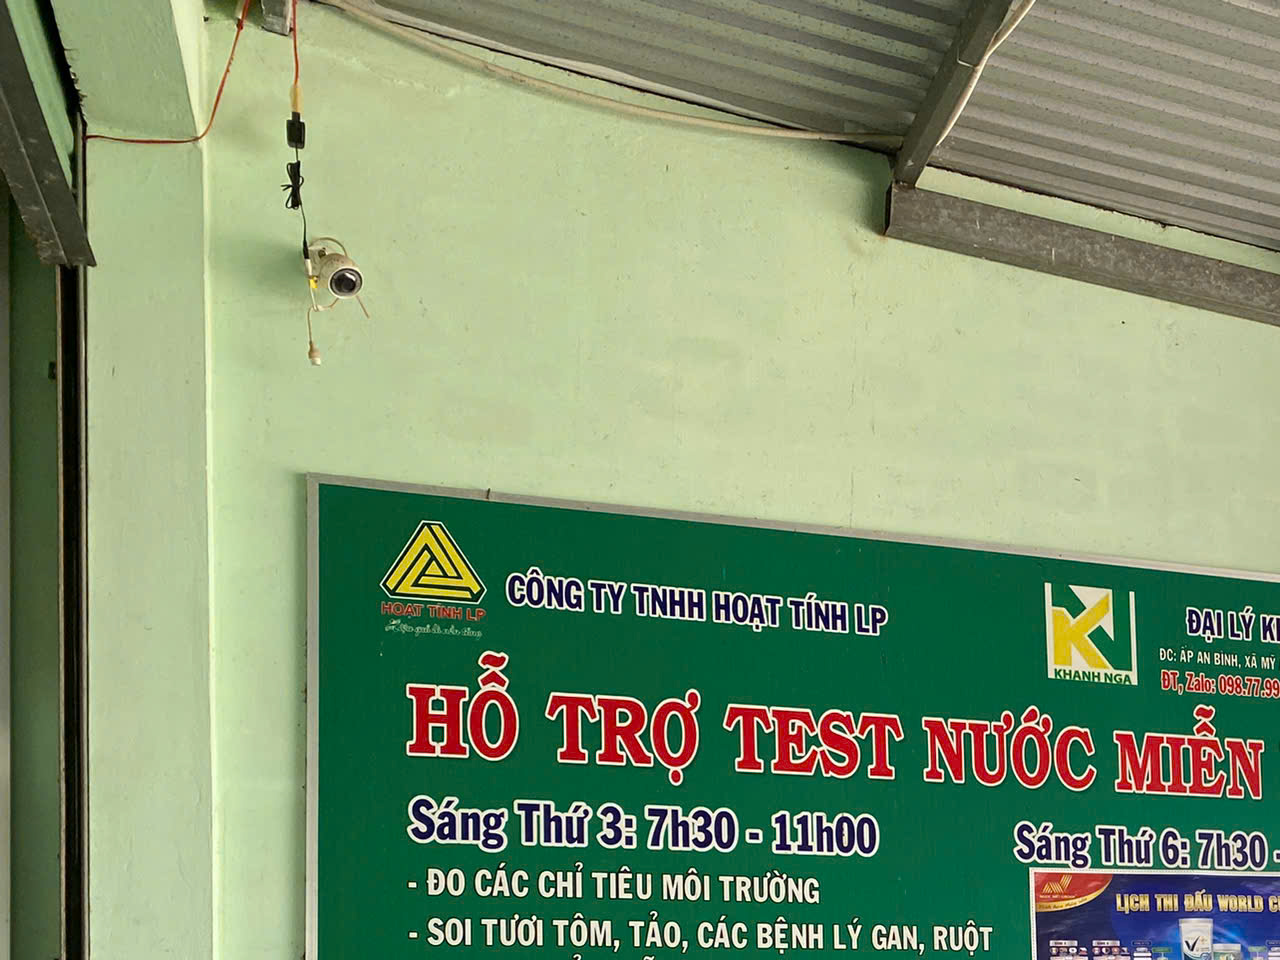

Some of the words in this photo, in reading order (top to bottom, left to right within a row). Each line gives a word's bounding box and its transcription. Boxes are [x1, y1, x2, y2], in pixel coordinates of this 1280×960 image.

[381, 601, 423, 618] HOẠT
[427, 603, 462, 619] TÍNH
[466, 608, 486, 621] LP
[505, 567, 584, 612] CÔNG
[587, 579, 624, 616] TY
[631, 585, 706, 622] TNHH
[712, 592, 781, 631] HOẠT
[789, 592, 849, 634] TÍNH
[854, 603, 889, 636] LP
[1186, 607, 1224, 642] ĐẠI
[1228, 606, 1255, 640] LÝ
[1054, 668, 1100, 682] KHANH
[1104, 672, 1132, 684] NGA
[1160, 648, 1176, 662] ĐC:
[1180, 646, 1193, 663] ẤP
[1197, 651, 1211, 664] AN
[1214, 649, 1241, 668] BÌNH,
[1245, 653, 1258, 668] XÃ
[1261, 655, 1276, 670] MỸ
[1161, 670, 1183, 694] ĐT,
[1185, 673, 1216, 694] Zalo:
[405, 651, 519, 760] HỖ
[545, 689, 701, 785] TRỢ
[724, 703, 903, 781] TEST
[922, 705, 1097, 792] NƯỚC
[1113, 704, 1264, 801] MIỄN
[408, 795, 508, 852] Sáng
[516, 799, 592, 849] Thứ
[598, 802, 637, 849] 3:
[644, 806, 739, 853] 7h30
[771, 811, 880, 857] 11h00
[1013, 820, 1091, 869] Sáng
[1099, 819, 1155, 866] Thứ
[1160, 832, 1191, 867] 6:
[1196, 830, 1269, 871] 7h30
[427, 868, 466, 897] ĐO
[474, 863, 529, 898] CÁC
[536, 861, 585, 899] CHỈ
[591, 866, 653, 900] TIÊU
[661, 869, 711, 902] MÔI
[718, 870, 821, 905] TRƯỜNG
[1115, 893, 1150, 914] LỊCH
[1154, 893, 1179, 912] THI
[1183, 889, 1213, 912] ĐẤU
[1216, 894, 1264, 912] WORLD
[427, 917, 472, 947] SOI
[480, 915, 544, 948] TƯƠI
[552, 915, 621, 952] TÔM,
[628, 909, 689, 953] TẢO,
[697, 914, 749, 950] CÁC
[755, 916, 825, 955] BỆNH
[833, 917, 863, 951] LÝ
[871, 924, 926, 956] GAN,
[932, 917, 994, 956] RUỘT
